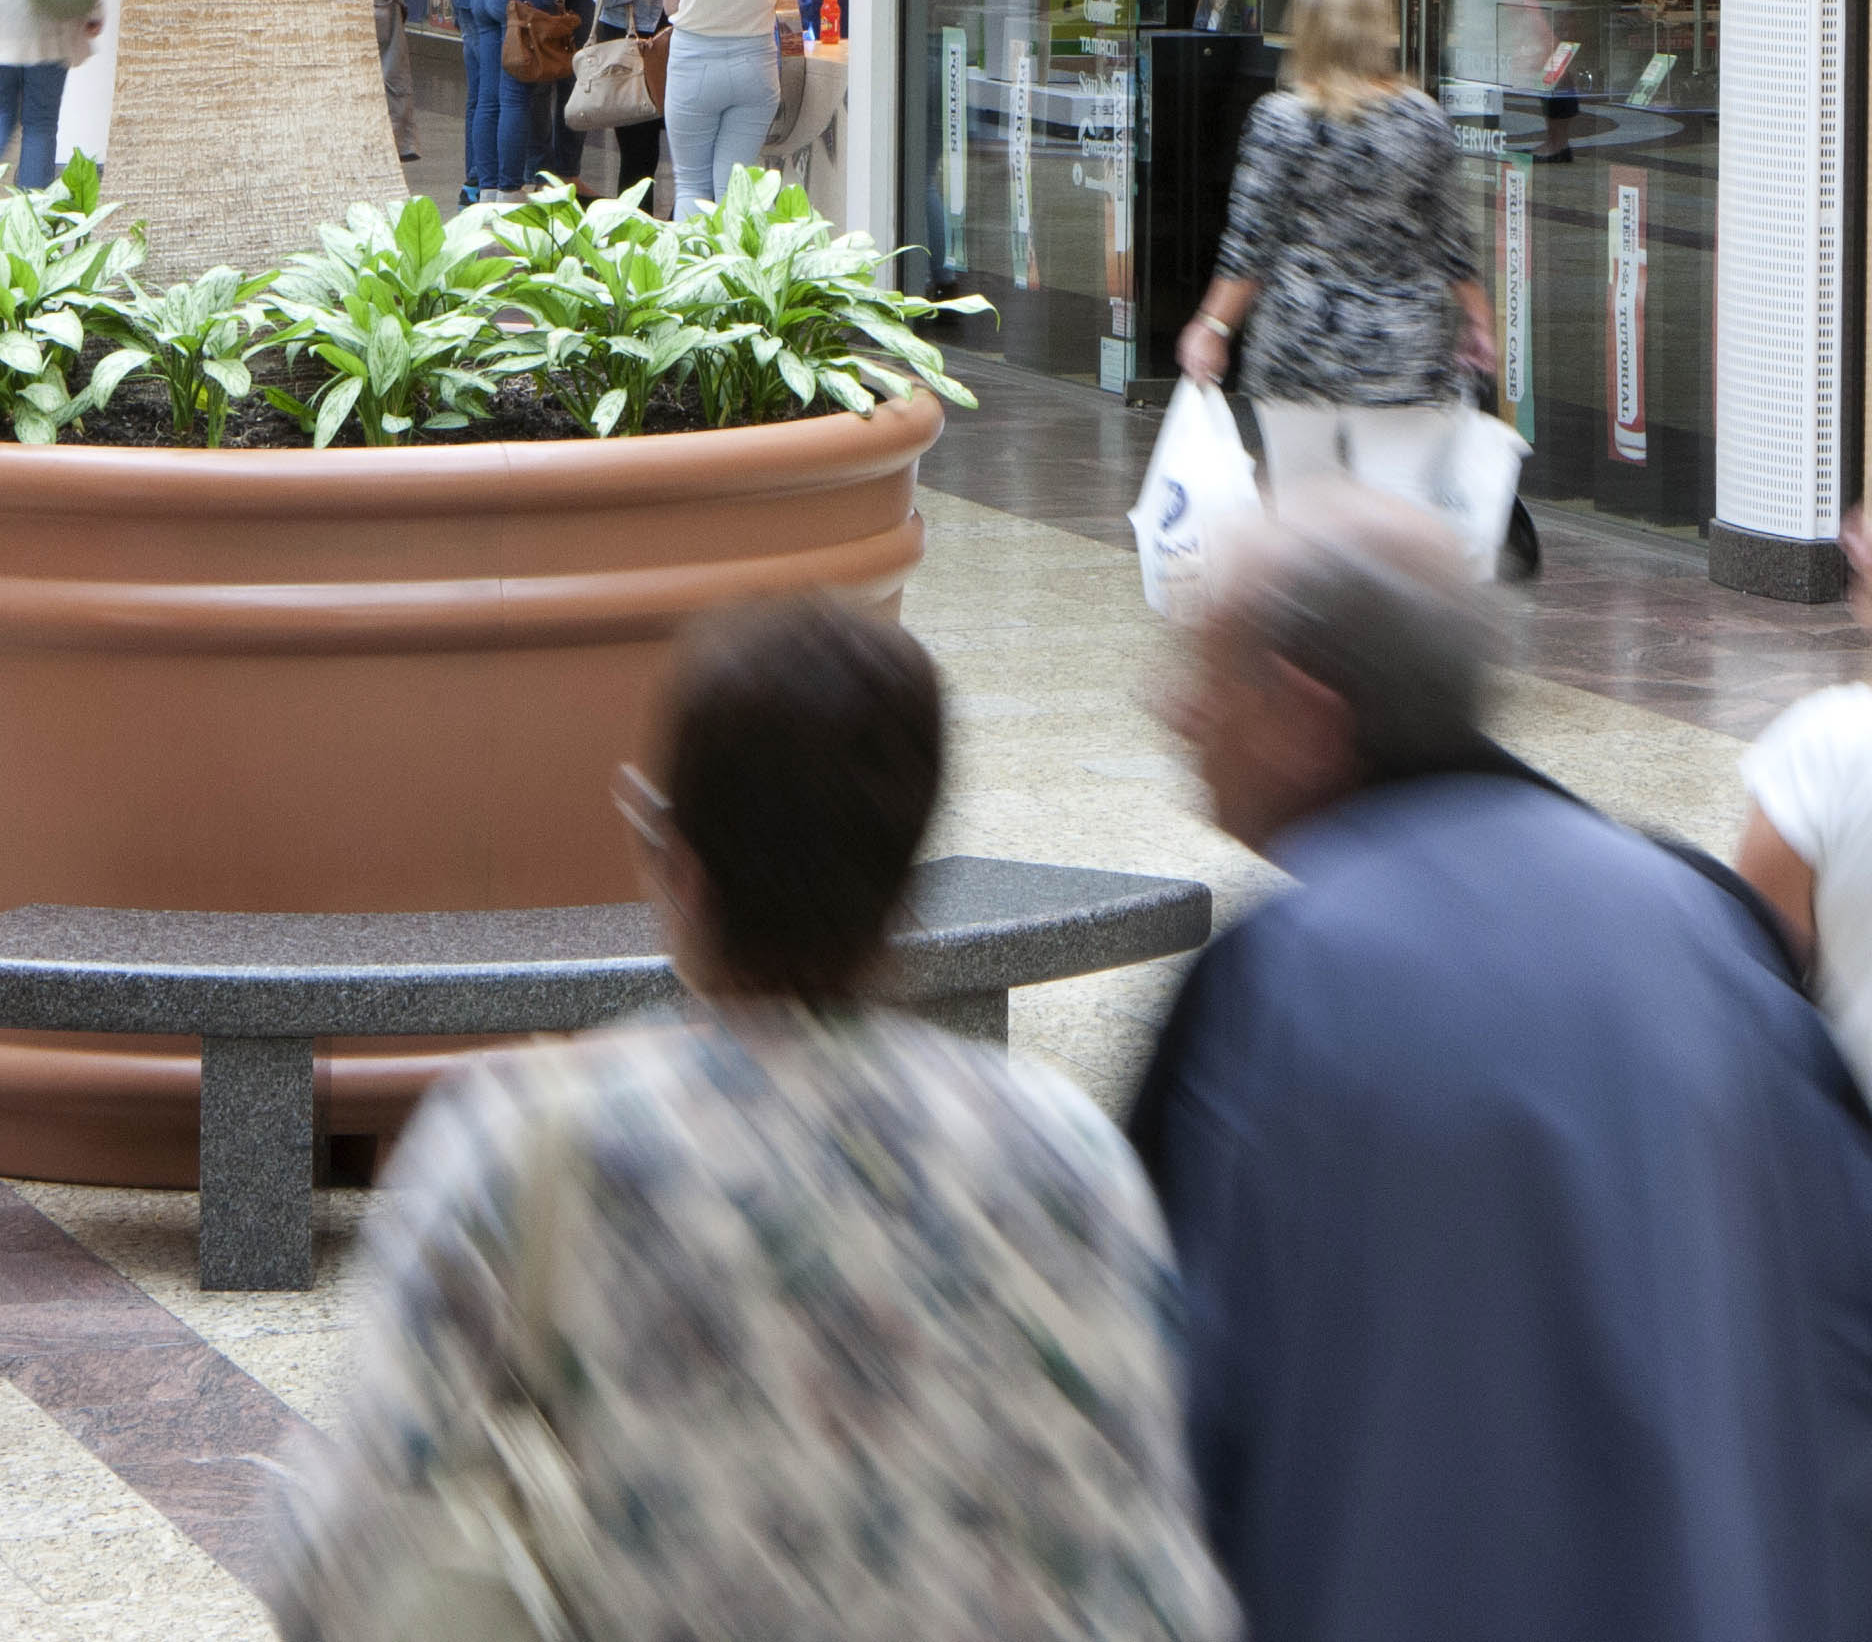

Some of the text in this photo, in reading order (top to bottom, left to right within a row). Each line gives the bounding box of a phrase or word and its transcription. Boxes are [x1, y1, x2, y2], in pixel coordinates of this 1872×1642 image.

[949, 47, 958, 153] POSTERS
[1454, 124, 1508, 155] SERVICE
[1622, 194, 1631, 253] FREE
[1509, 177, 1518, 399] FREE CANON CASE
[1620, 309, 1630, 419] TUTORIAL
